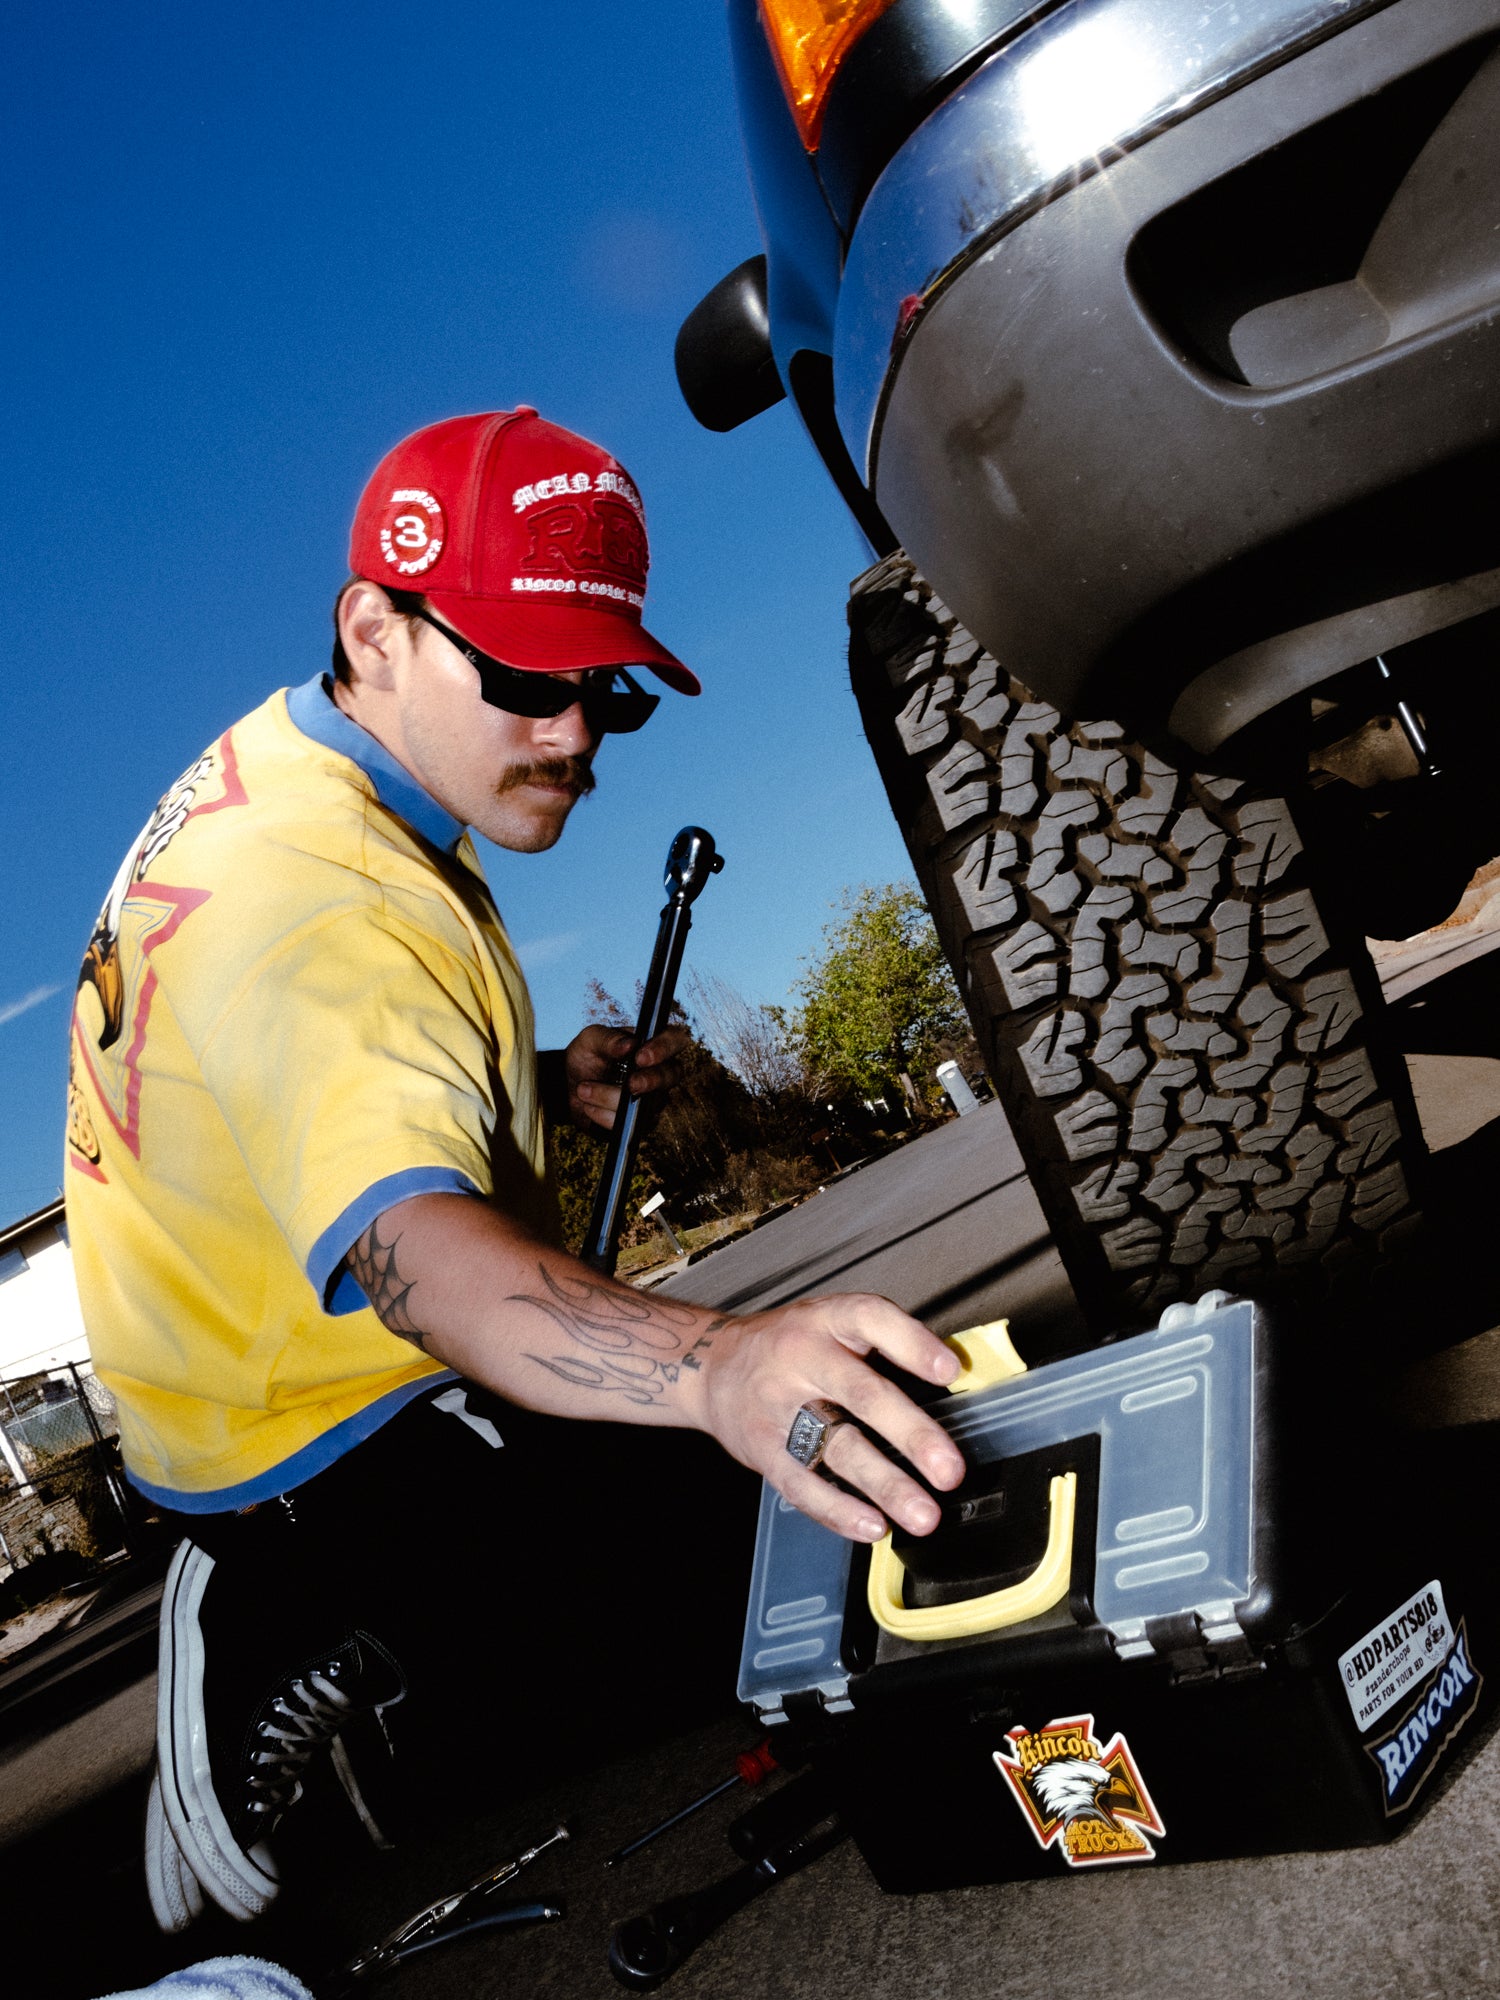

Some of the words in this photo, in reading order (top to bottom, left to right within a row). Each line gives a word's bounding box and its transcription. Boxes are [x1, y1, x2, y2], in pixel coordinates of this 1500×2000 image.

[395, 515, 428, 548] 3
[398, 538, 442, 573] POWER
[511, 578, 576, 592] RINCON
[1345, 1592, 1438, 1687] @HDPARTS818
[1359, 1695, 1382, 1720] PARTS
[1382, 1683, 1396, 1700] FOR
[1396, 1666, 1414, 1687] YOUR
[1414, 1657, 1424, 1671] HD
[1377, 1635, 1473, 1797] RINCON
[1017, 1733, 1101, 1780] Rincon
[1064, 1830, 1147, 1856] TRUCKS
